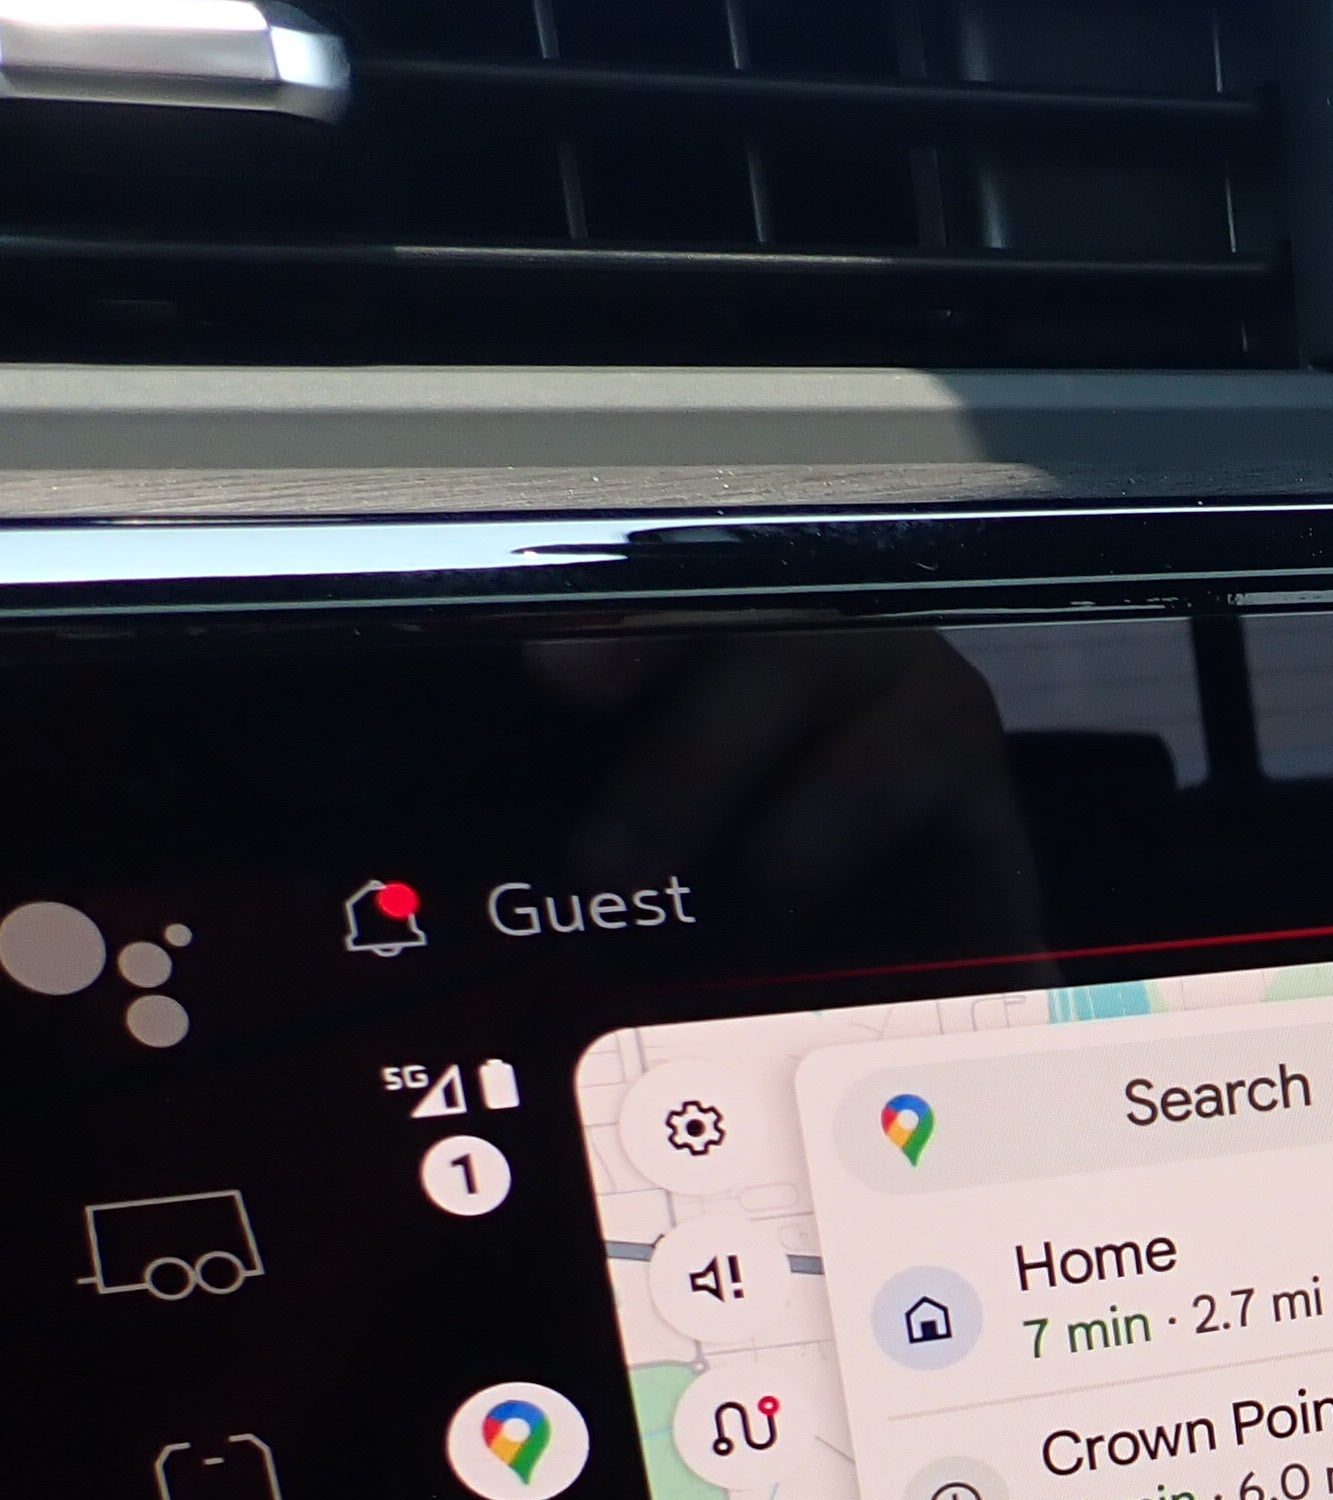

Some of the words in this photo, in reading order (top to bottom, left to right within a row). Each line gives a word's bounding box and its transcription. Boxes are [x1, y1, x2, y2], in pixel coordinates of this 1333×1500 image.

[488, 875, 696, 937] Guest
[382, 1064, 428, 1090] 5G
[1124, 1063, 1311, 1126] Search
[450, 1153, 478, 1194] 1
[1016, 1237, 1177, 1291] Home
[1023, 1318, 1049, 1358] 7
[1068, 1305, 1151, 1353] min
[1193, 1288, 1255, 1334] 2.7
[1273, 1275, 1323, 1322] mi
[1043, 1417, 1217, 1476] Crown
